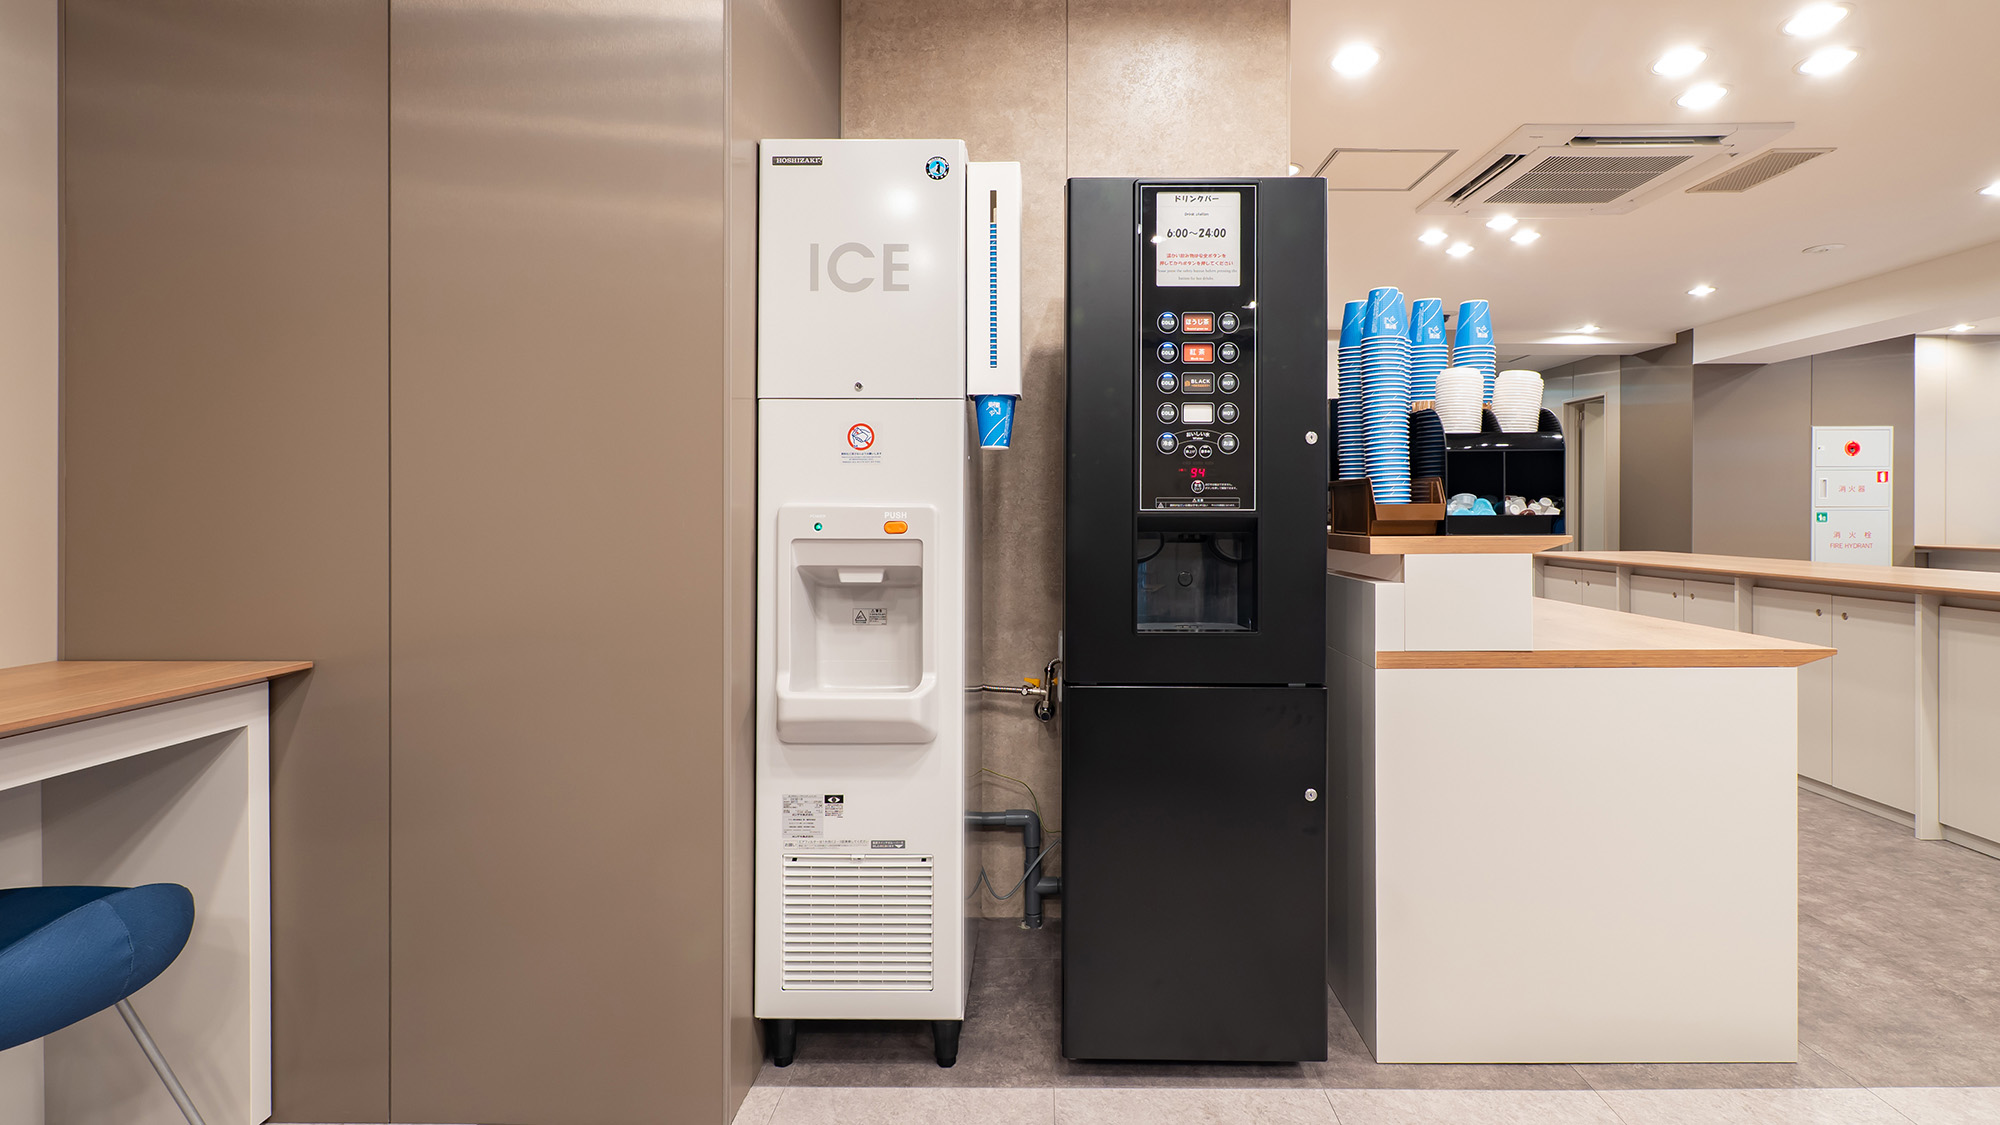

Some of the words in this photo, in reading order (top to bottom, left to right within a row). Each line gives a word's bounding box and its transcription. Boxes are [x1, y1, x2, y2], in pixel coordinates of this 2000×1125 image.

[1175, 195, 1219, 203] ドリンクバー
[809, 242, 910, 292] ICE
[1185, 318, 1209, 326] ほうじ茶
[1190, 467, 1206, 478] 94
[884, 511, 908, 519] PUSH
[1833, 531, 1872, 539] 消火栓
